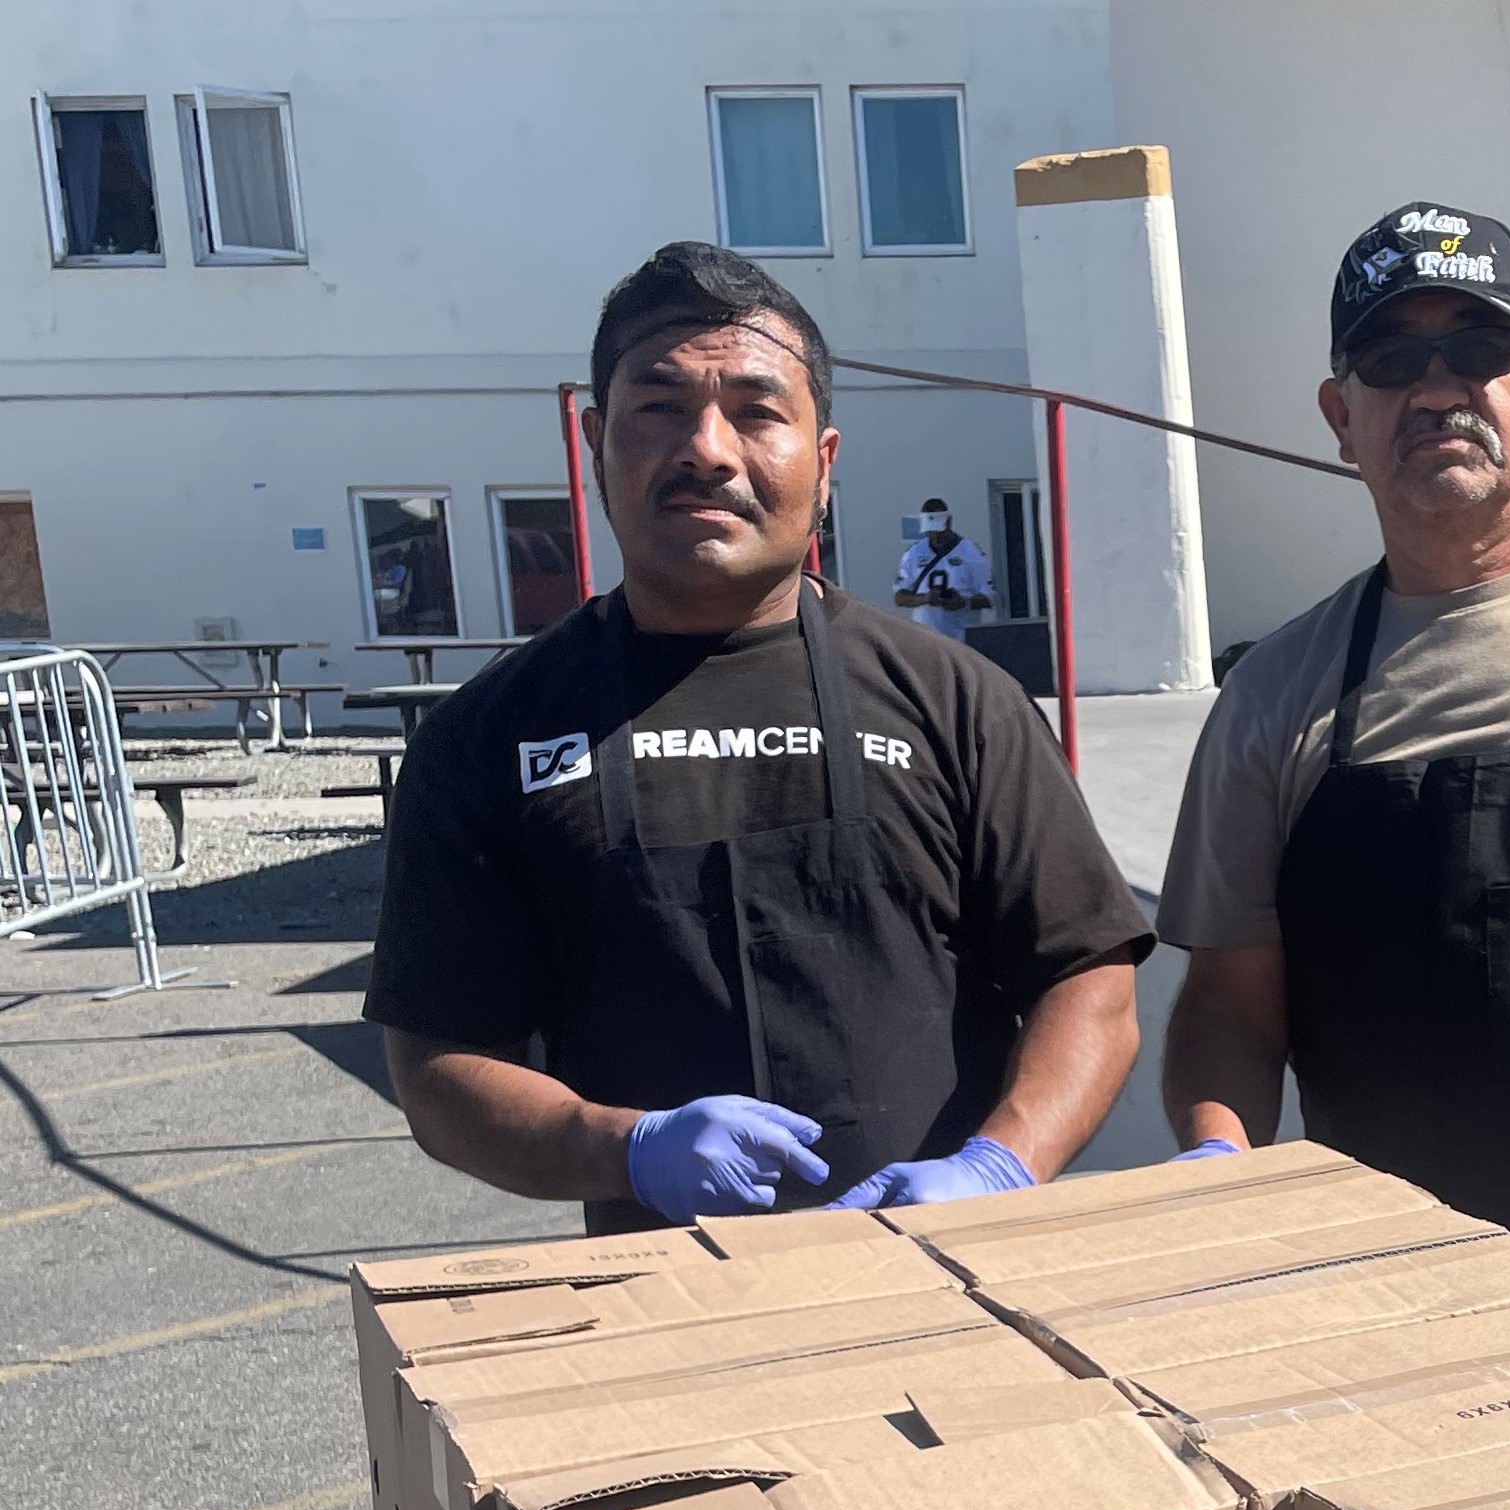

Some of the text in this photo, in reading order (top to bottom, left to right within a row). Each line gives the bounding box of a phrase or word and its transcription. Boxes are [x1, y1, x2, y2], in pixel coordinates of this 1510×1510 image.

[1396, 208, 1471, 235] Man
[1440, 236, 1465, 254] of
[1414, 252, 1496, 283] Faith
